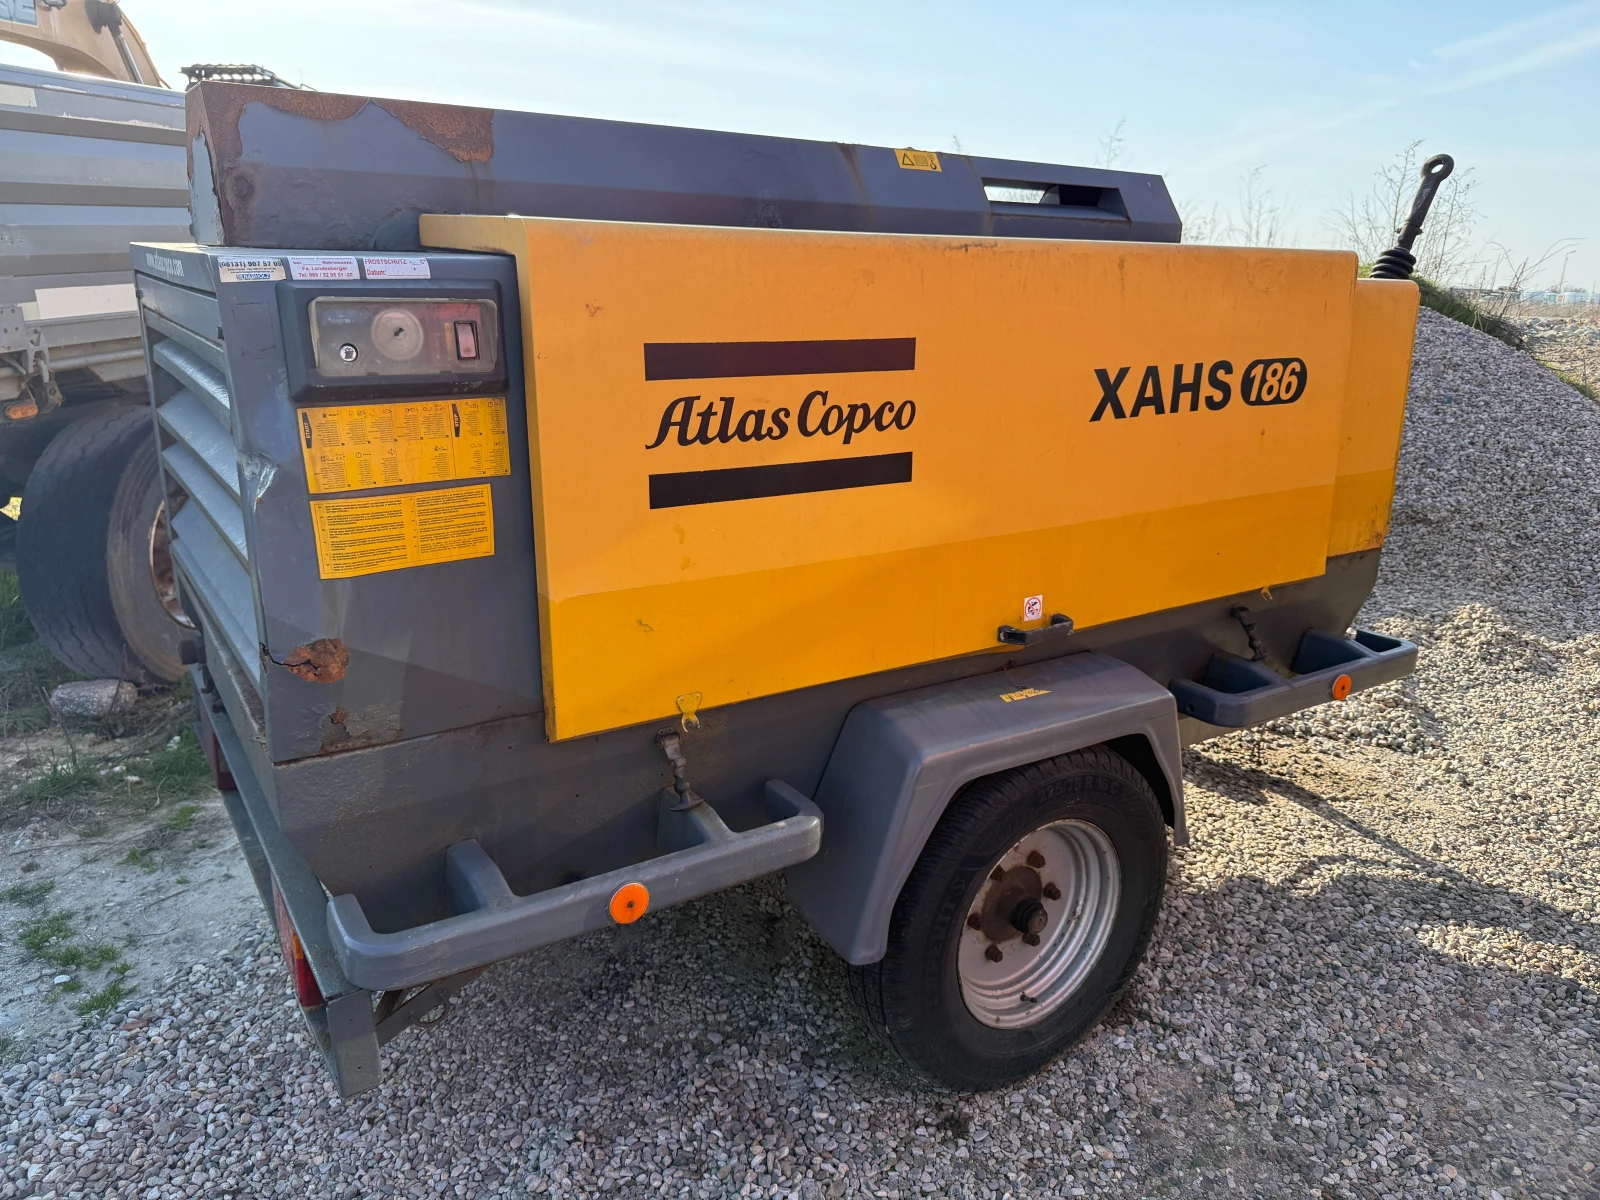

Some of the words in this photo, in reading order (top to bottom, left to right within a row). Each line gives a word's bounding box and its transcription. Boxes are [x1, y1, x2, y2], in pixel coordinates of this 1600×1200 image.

[366, 268, 387, 276] Datum:
[1089, 360, 1233, 422] XAHS
[1249, 361, 1301, 402] 186
[303, 421, 311, 440] START
[645, 395, 790, 450] Atlas
[797, 390, 916, 445] Copco
